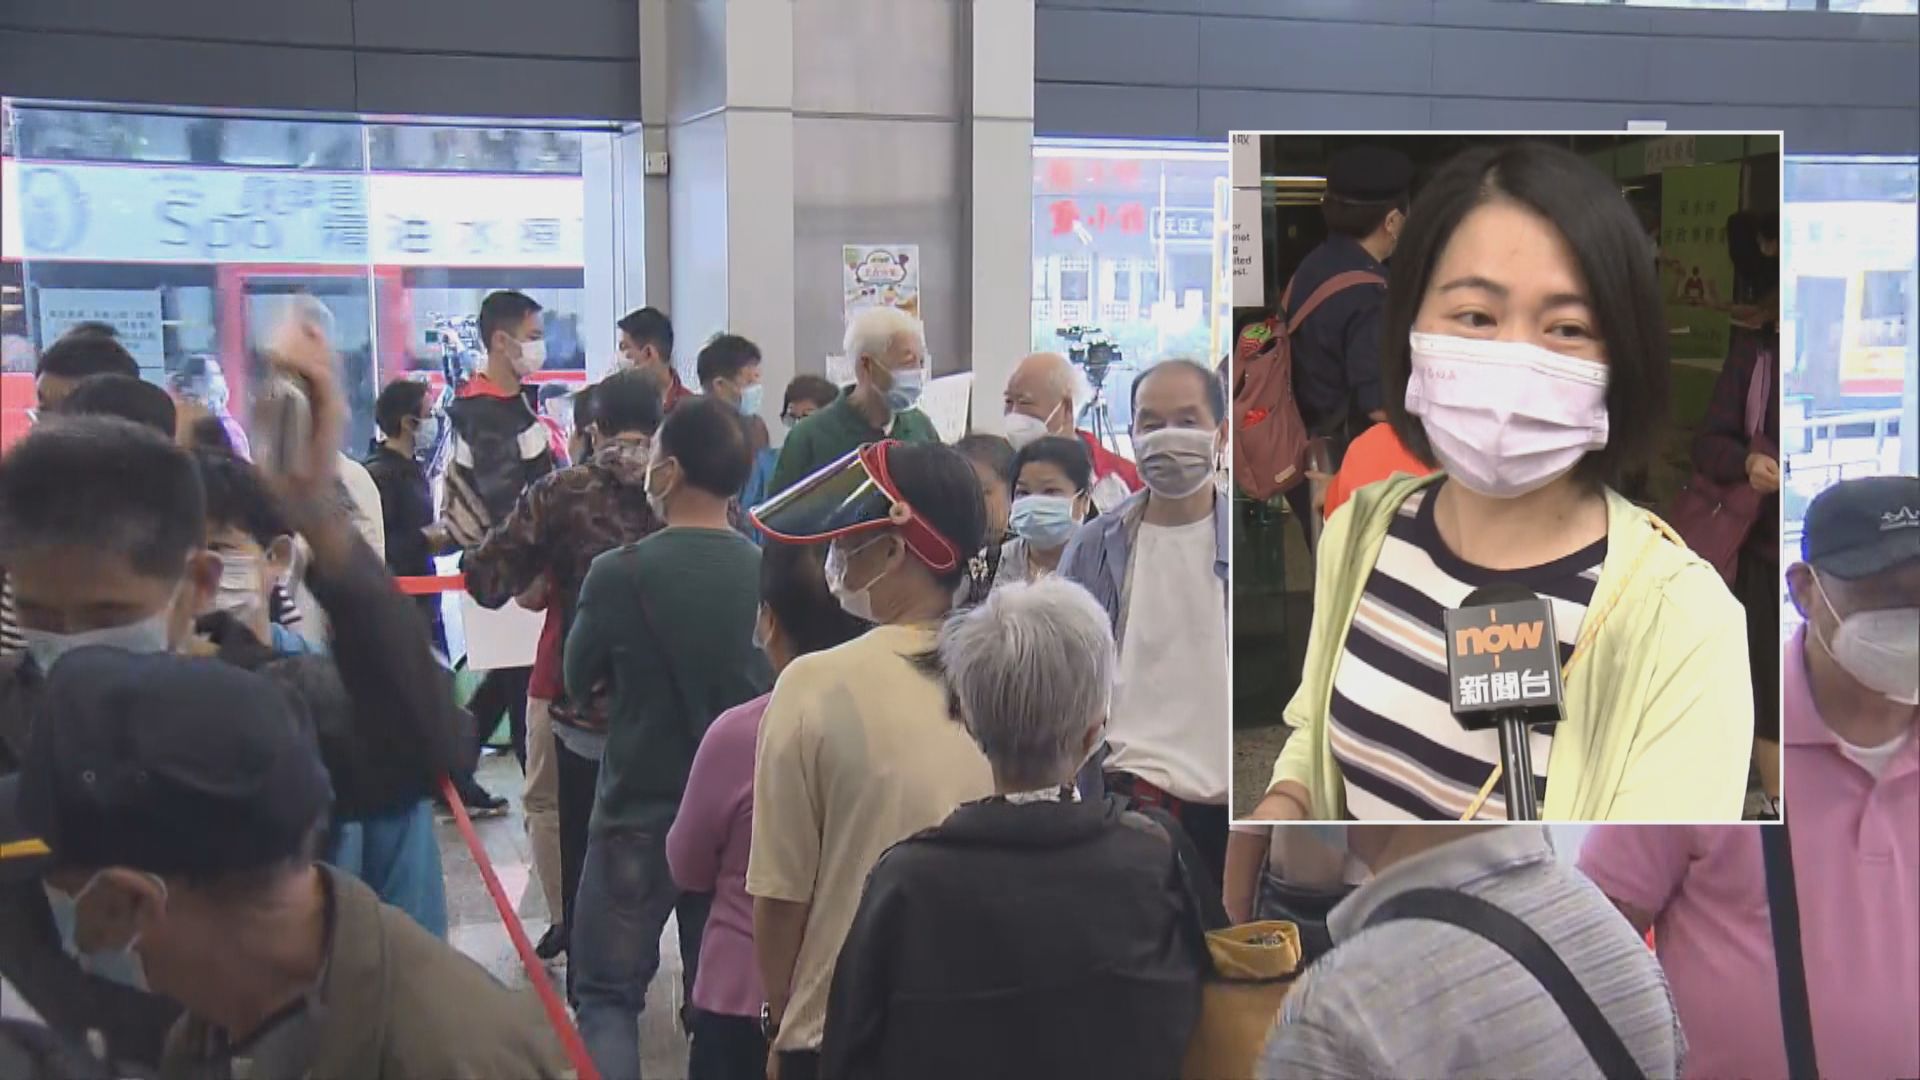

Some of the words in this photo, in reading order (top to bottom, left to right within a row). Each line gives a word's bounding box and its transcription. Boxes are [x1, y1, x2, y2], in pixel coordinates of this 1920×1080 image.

[1455, 619, 1544, 656] now
[1458, 668, 1551, 706] 新聞台
